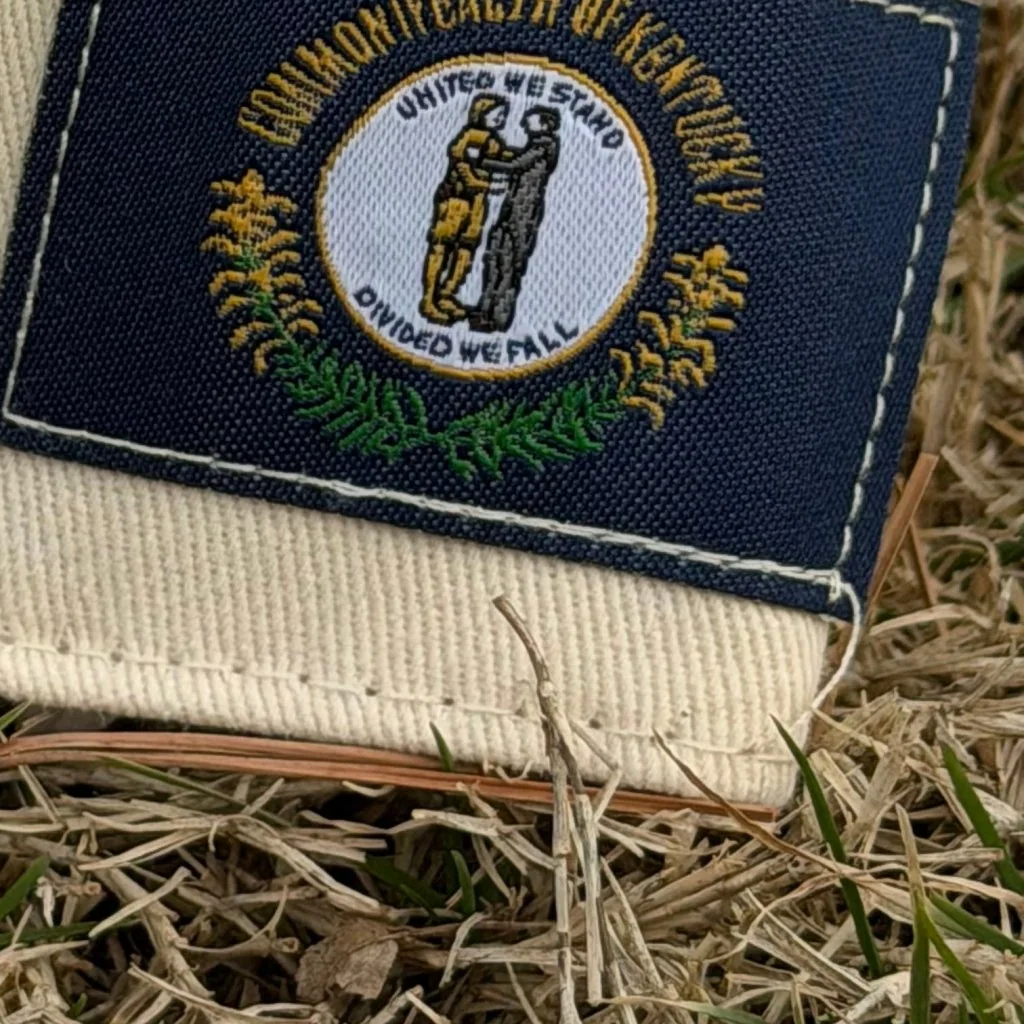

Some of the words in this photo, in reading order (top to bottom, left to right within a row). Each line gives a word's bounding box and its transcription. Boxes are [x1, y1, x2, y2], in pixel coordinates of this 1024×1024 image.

[396, 70, 496, 121] UNITED
[504, 70, 547, 98] WE
[548, 81, 625, 150] STAND
[614, 12, 765, 214] KENTUCKY
[353, 285, 453, 358] DIVIDED
[459, 336, 502, 364] WE
[506, 321, 579, 364] FALL
